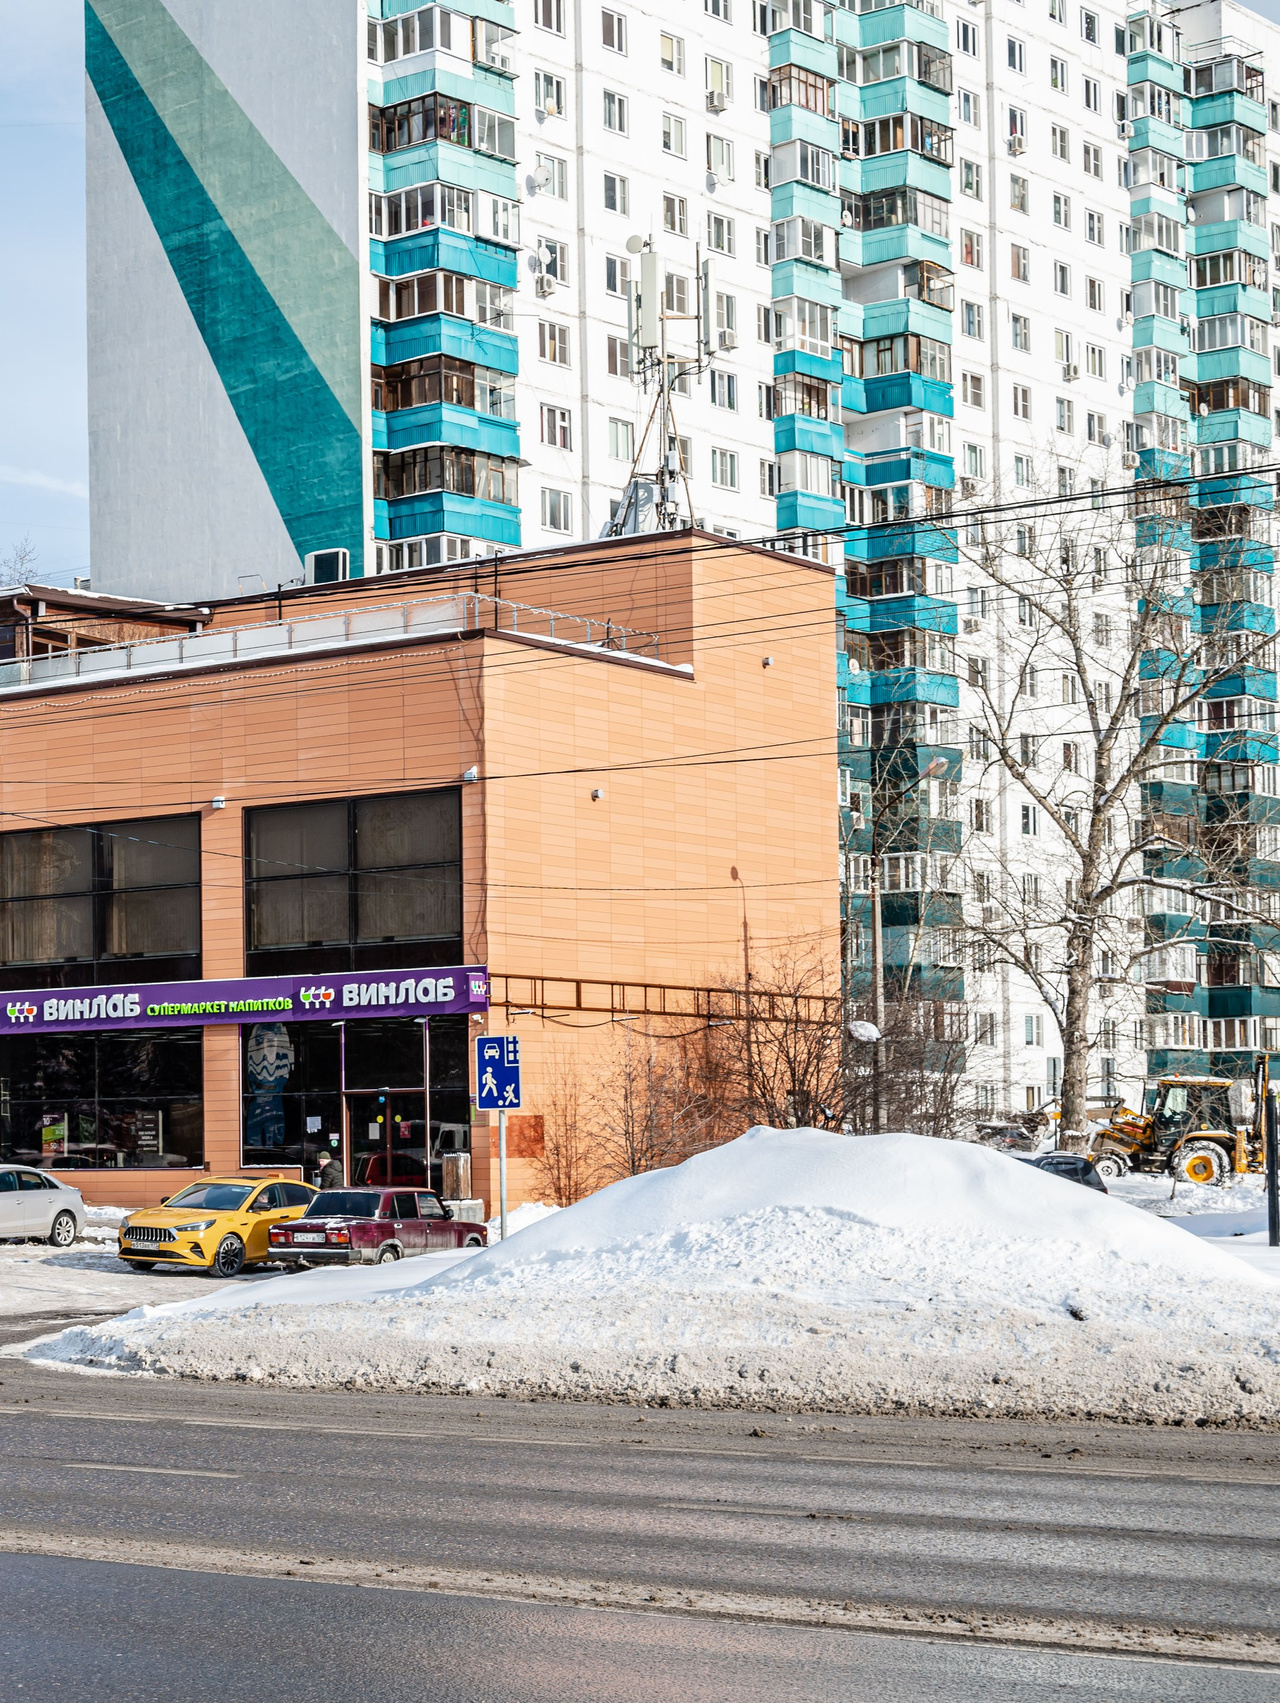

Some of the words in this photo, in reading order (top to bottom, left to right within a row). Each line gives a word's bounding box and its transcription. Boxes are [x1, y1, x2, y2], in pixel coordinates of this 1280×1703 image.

[342, 977, 455, 1007] ВИНЛАБ
[43, 993, 141, 1021] ВИНЛАБ
[146, 1001, 227, 1016] СУПЕРМАРКЕТ
[228, 997, 293, 1012] НАПИТКОВ
[1123, 1114, 1144, 1124] JCB
